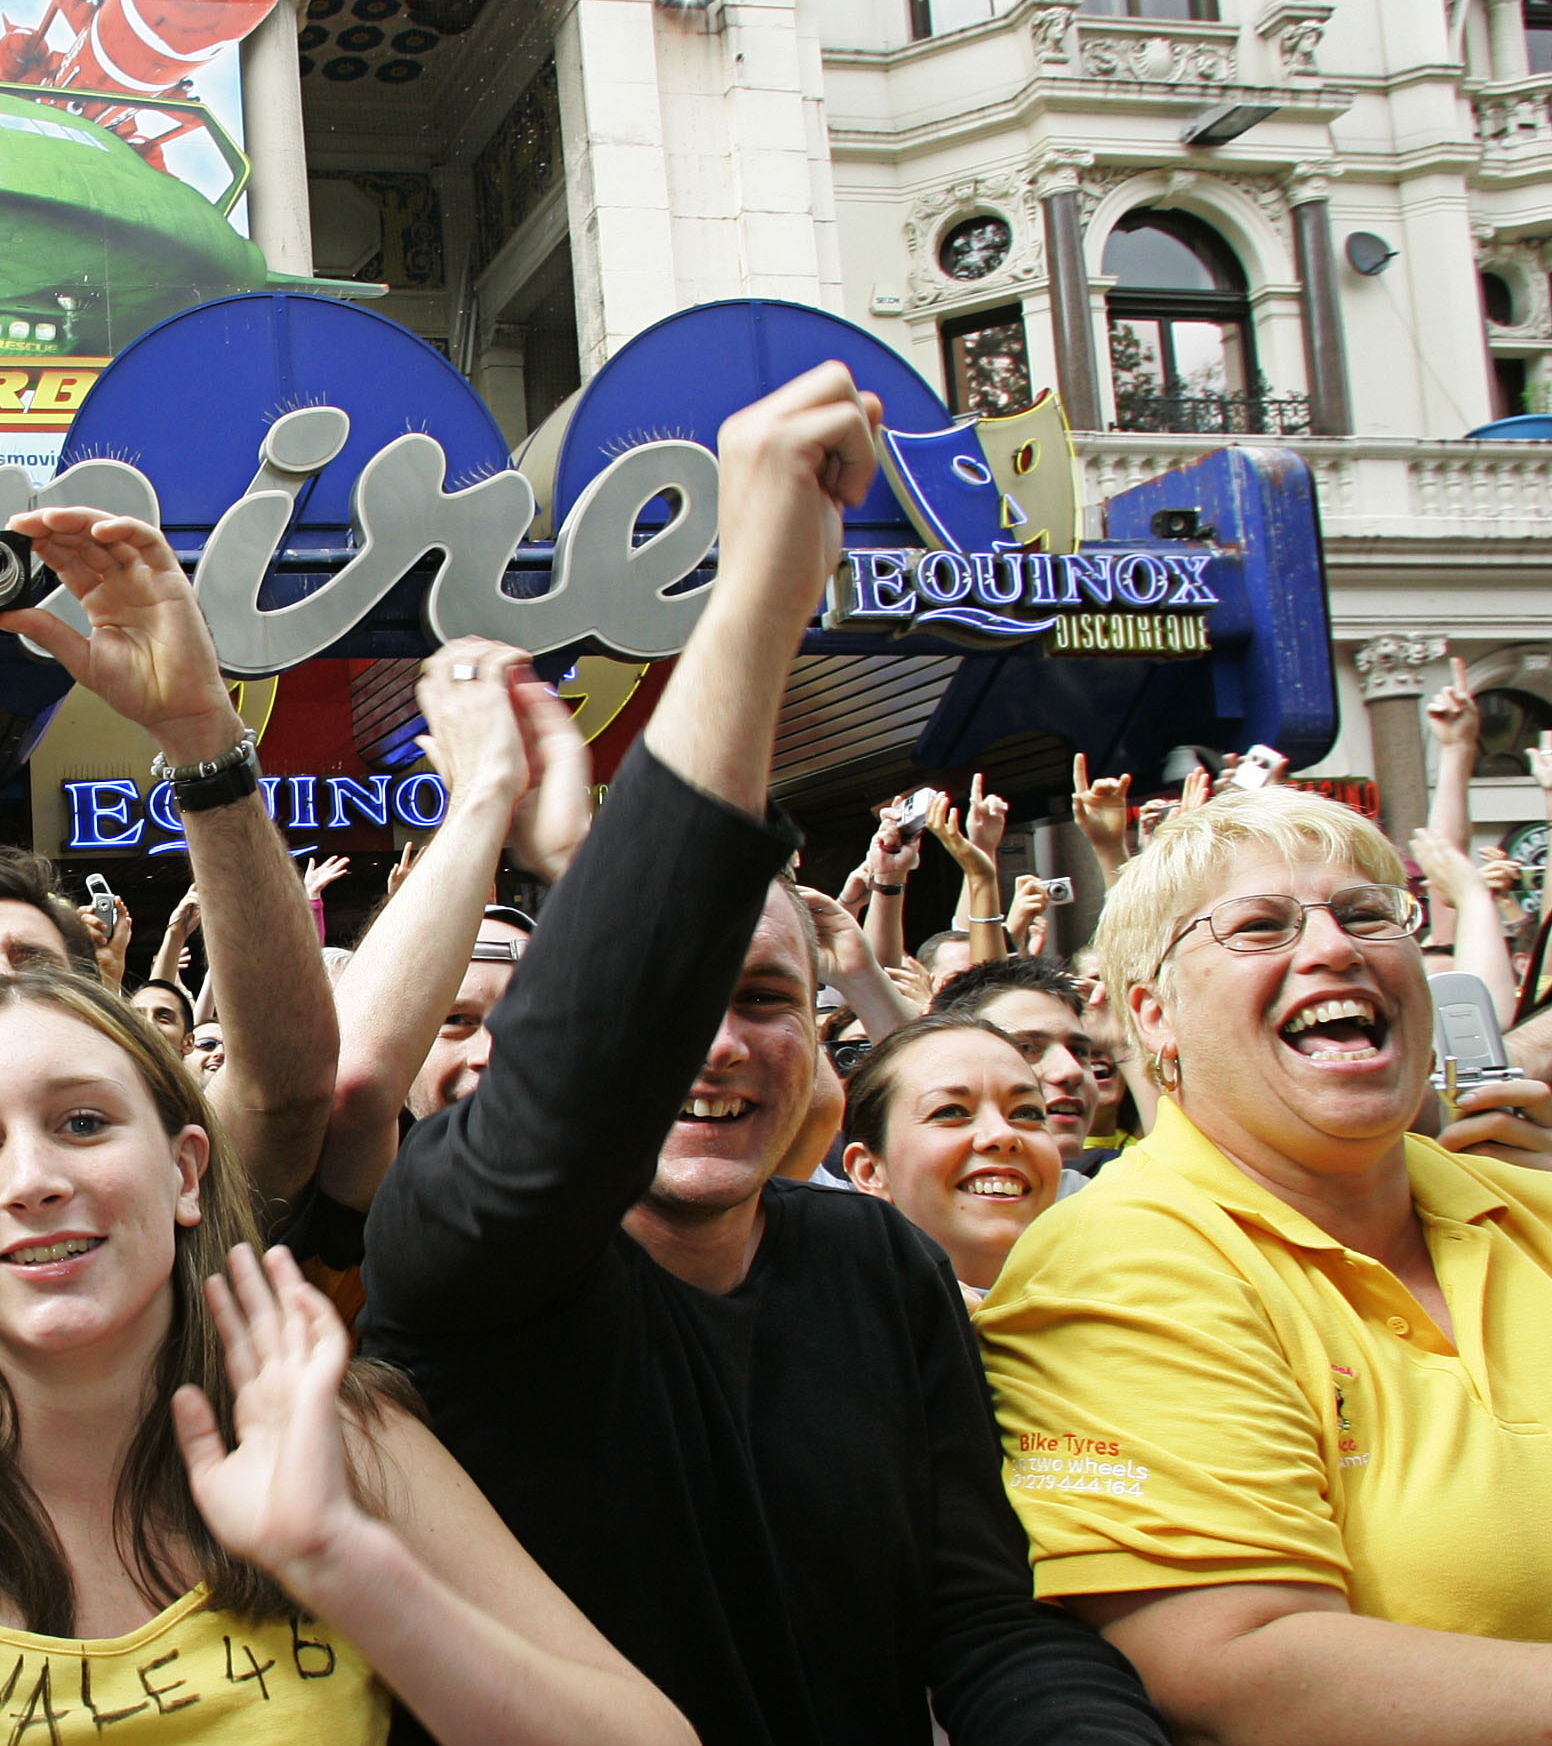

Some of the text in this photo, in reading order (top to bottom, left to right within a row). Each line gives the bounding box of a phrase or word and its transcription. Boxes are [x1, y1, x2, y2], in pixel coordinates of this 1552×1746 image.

[848, 549, 1219, 633] EQUINOX
[1056, 613, 1210, 652] DISCOTHEQUE
[1019, 1433, 1120, 1456] Bike Tyres
[1029, 1459, 1064, 1472] two
[1068, 1456, 1149, 1480] wheels
